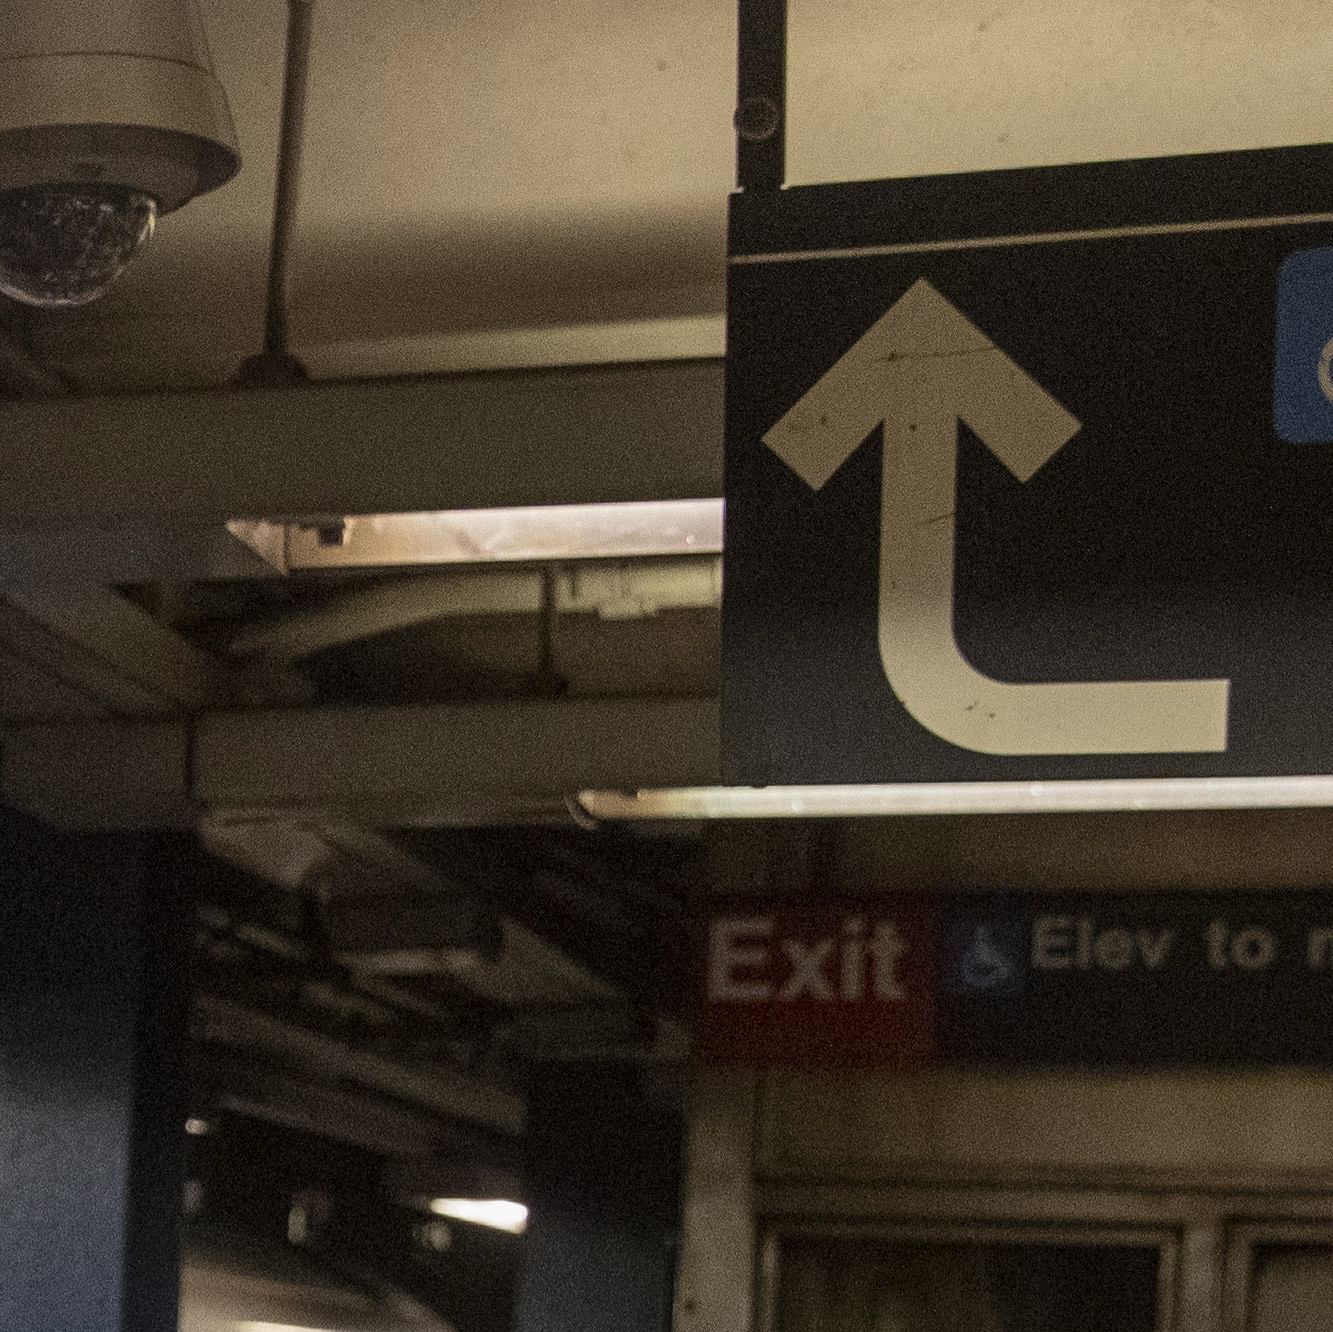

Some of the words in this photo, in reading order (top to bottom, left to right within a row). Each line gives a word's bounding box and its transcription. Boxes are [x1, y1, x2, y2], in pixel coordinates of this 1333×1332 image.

[709, 915, 908, 1001] Exit
[1034, 914, 1175, 970] Elev
[1204, 919, 1277, 970] to
